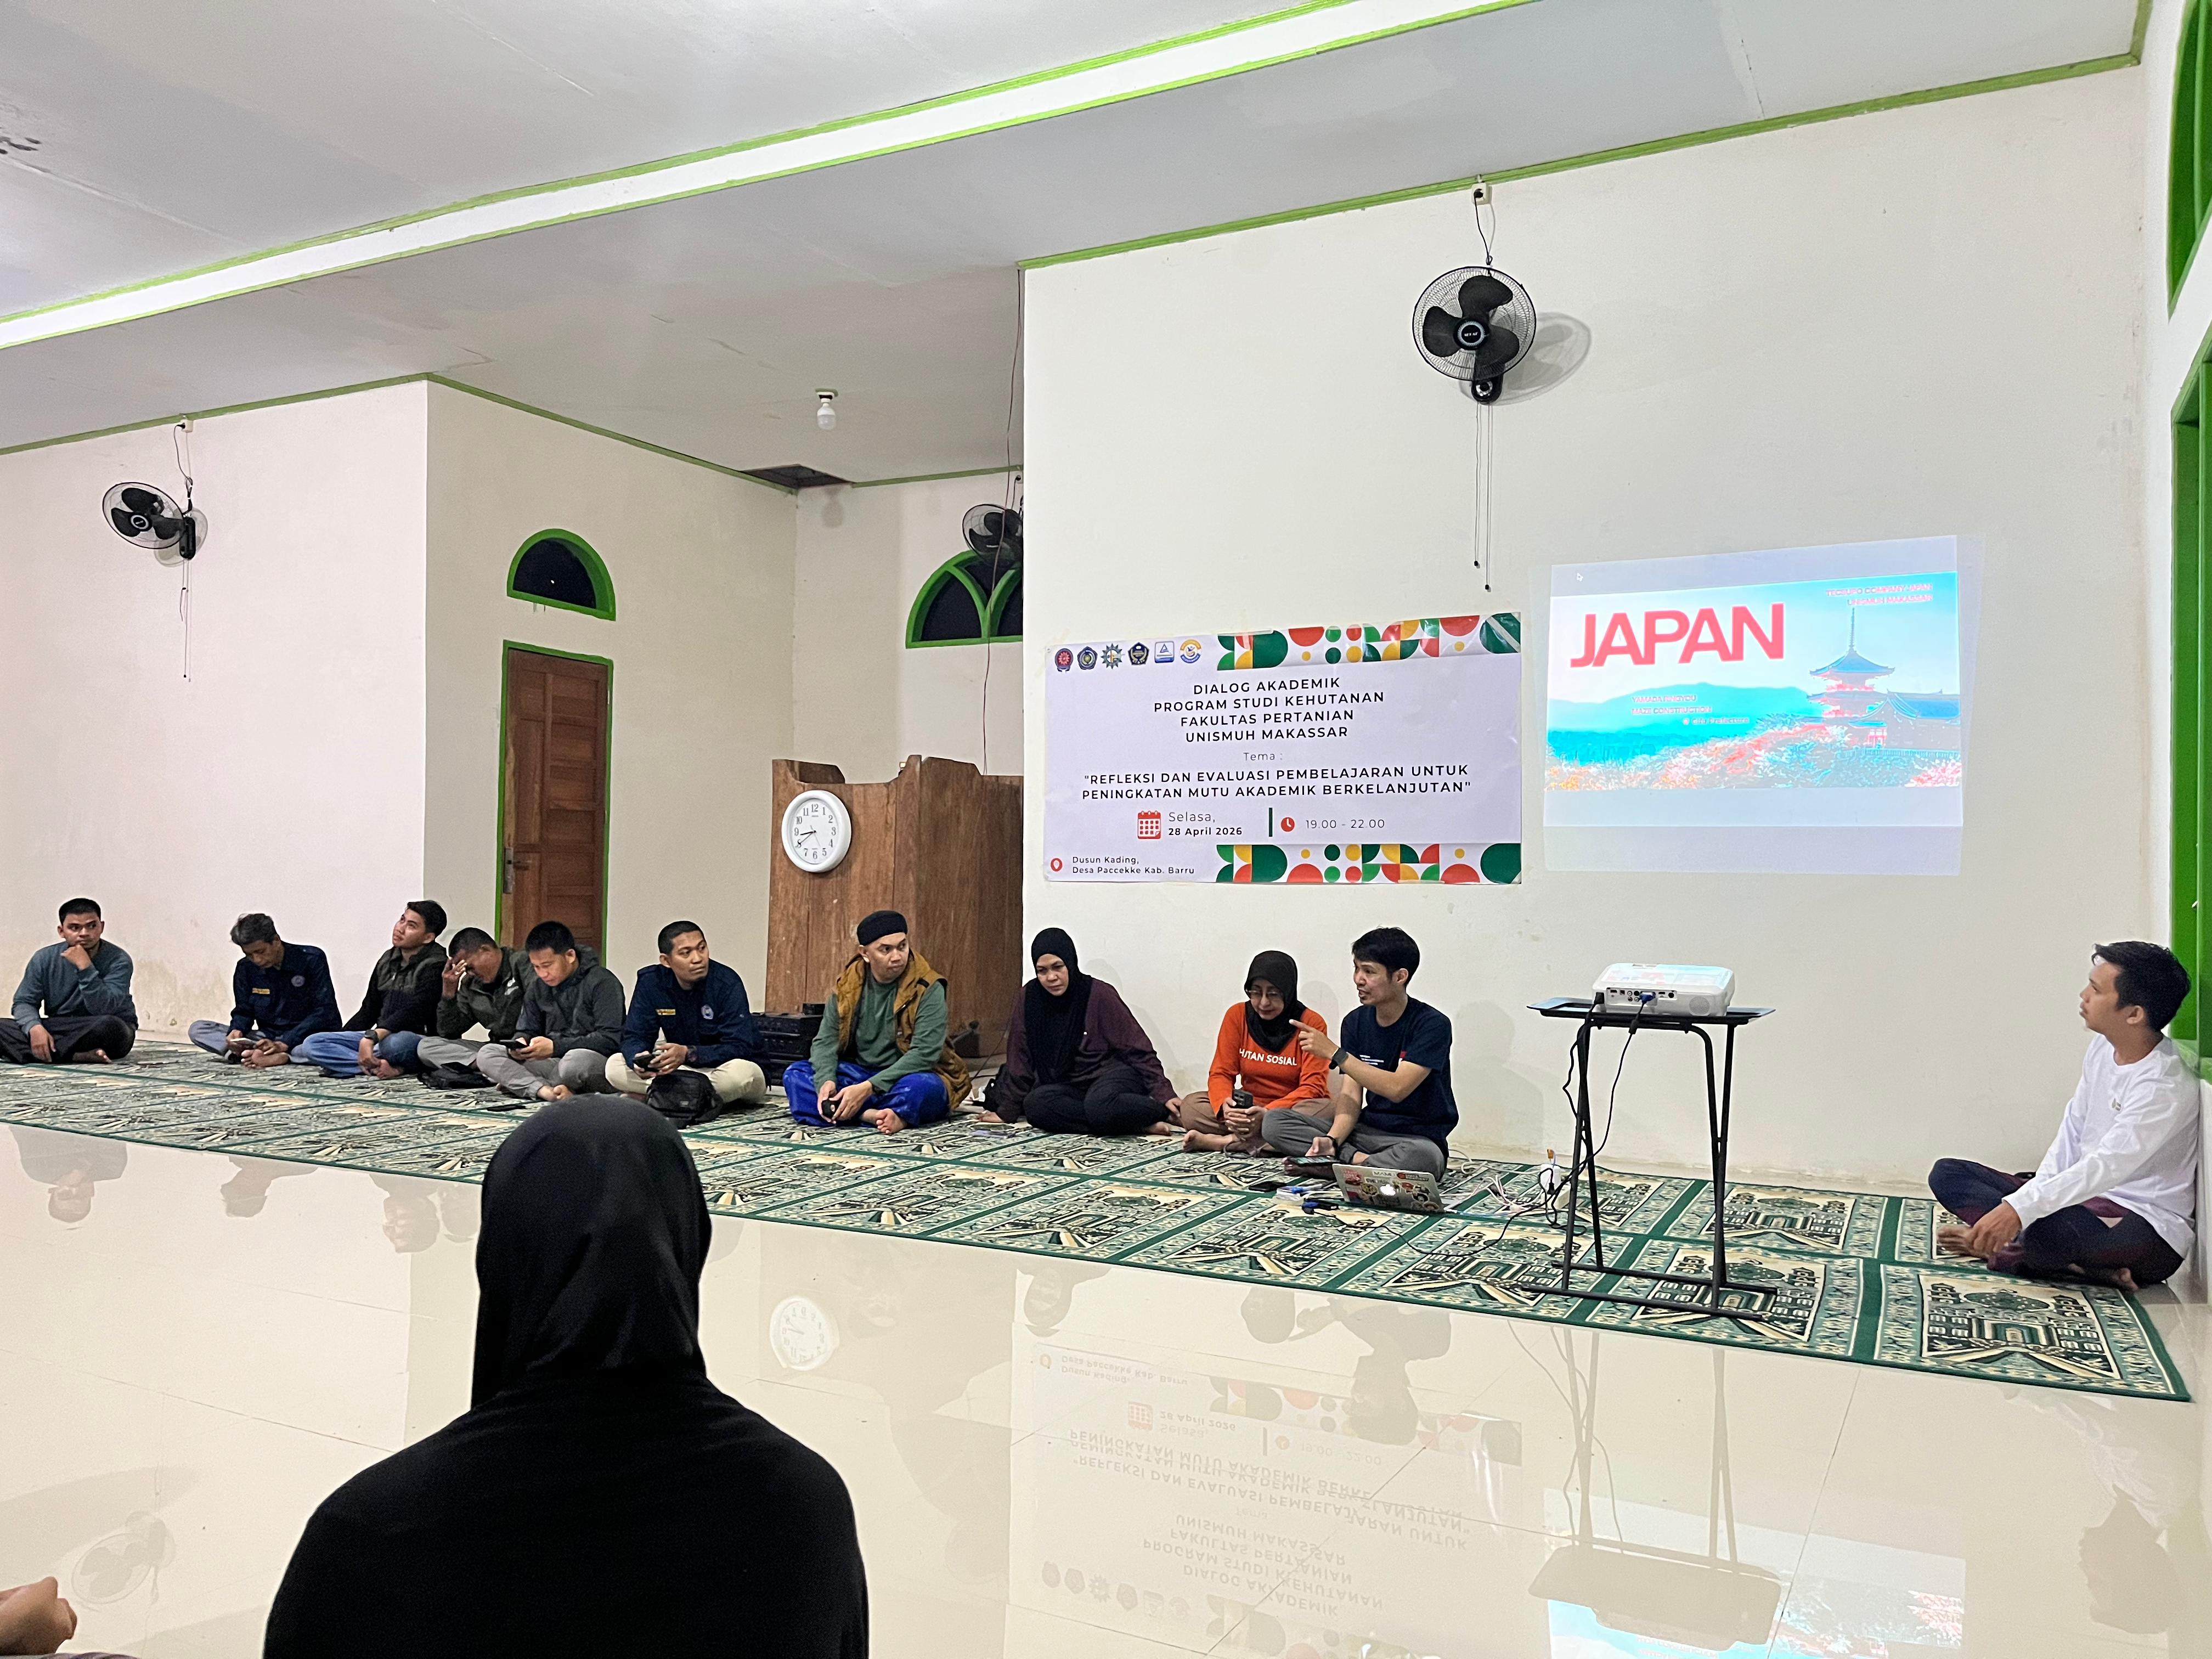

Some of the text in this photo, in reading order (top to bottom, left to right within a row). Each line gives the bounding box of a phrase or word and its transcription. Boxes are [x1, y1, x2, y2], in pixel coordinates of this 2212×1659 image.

[1571, 603, 1784, 667] JAPAN
[1194, 677, 1340, 695] DIALOG AKADEMIK
[1154, 692, 1384, 713] PROGRAM STUDI KEHUTANAN
[1181, 709, 1353, 727] FAKULTAS PERTANIAN
[1186, 726, 1347, 743] UNISMUH MAKASSAR
[1243, 752, 1275, 761] Tema
[1161, 772, 1190, 782] DAN
[1197, 770, 1269, 782] EVALUASI
[1277, 766, 1403, 780] PEMBELAJARAN
[1412, 764, 1468, 776] UNTUK
[1082, 788, 1182, 800] PENINGKATAN
[1188, 787, 1229, 798] MUTU
[1235, 785, 1316, 797] AKADEMIK
[803, 808, 809, 816] 11
[811, 804, 819, 812] 12
[822, 806, 826, 815] 1
[796, 816, 803, 824] 10
[828, 815, 833, 823] 2
[1169, 811, 1215, 823] Selasa,
[1306, 820, 1336, 829] 19.00
[1350, 819, 1385, 828] 22.00
[794, 827, 799, 836] 9
[831, 827, 836, 836] 3
[1184, 827, 1211, 837] April
[1216, 827, 1242, 836] 2026
[828, 839, 833, 848] 4
[804, 848, 808, 857] 7
[812, 851, 817, 860] 6
[822, 848, 827, 856] 5
[1104, 856, 1139, 865] Kading,
[1266, 1054, 1297, 1066] SOSIAL
